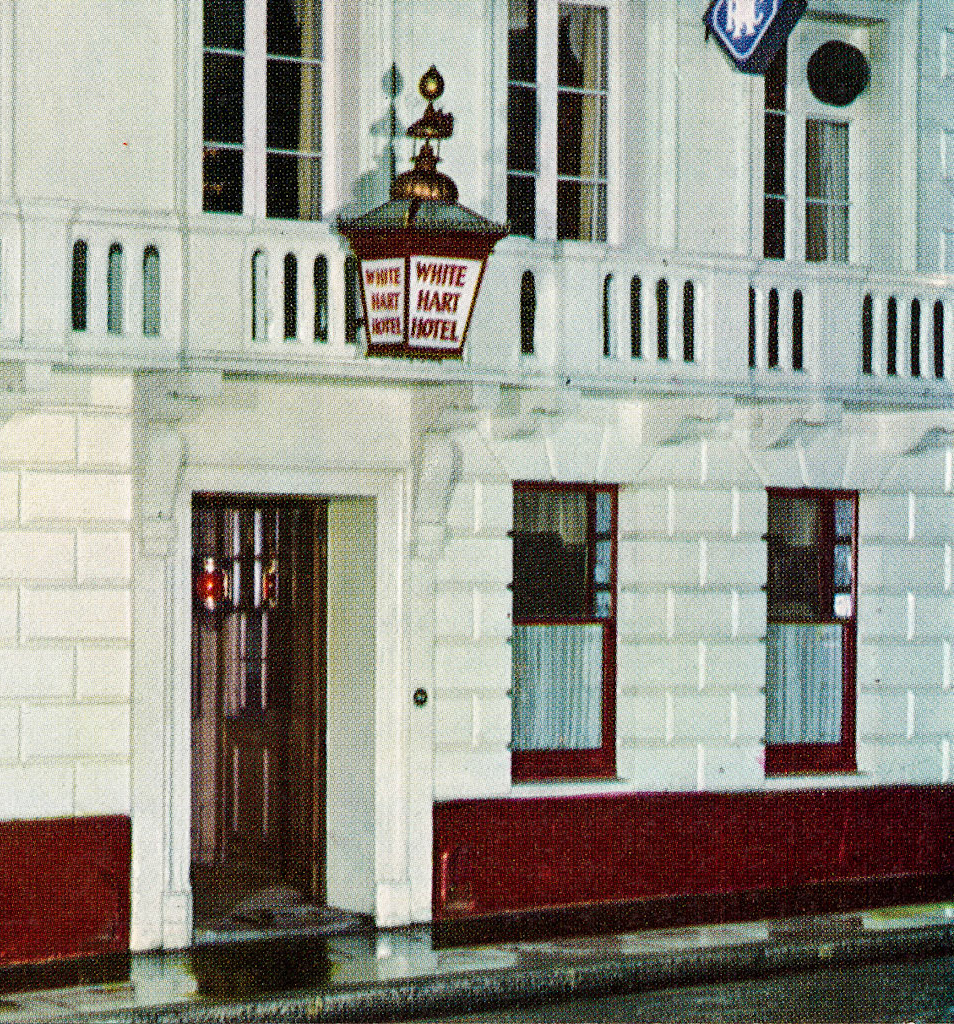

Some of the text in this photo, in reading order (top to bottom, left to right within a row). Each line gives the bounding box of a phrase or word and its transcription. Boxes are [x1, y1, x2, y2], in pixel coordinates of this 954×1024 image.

[364, 266, 402, 288] WHITE
[416, 261, 468, 287] WHITE
[371, 292, 401, 311] HART
[416, 289, 462, 314] HART
[371, 317, 402, 336] HOTEL
[410, 317, 458, 342] HOTEL
